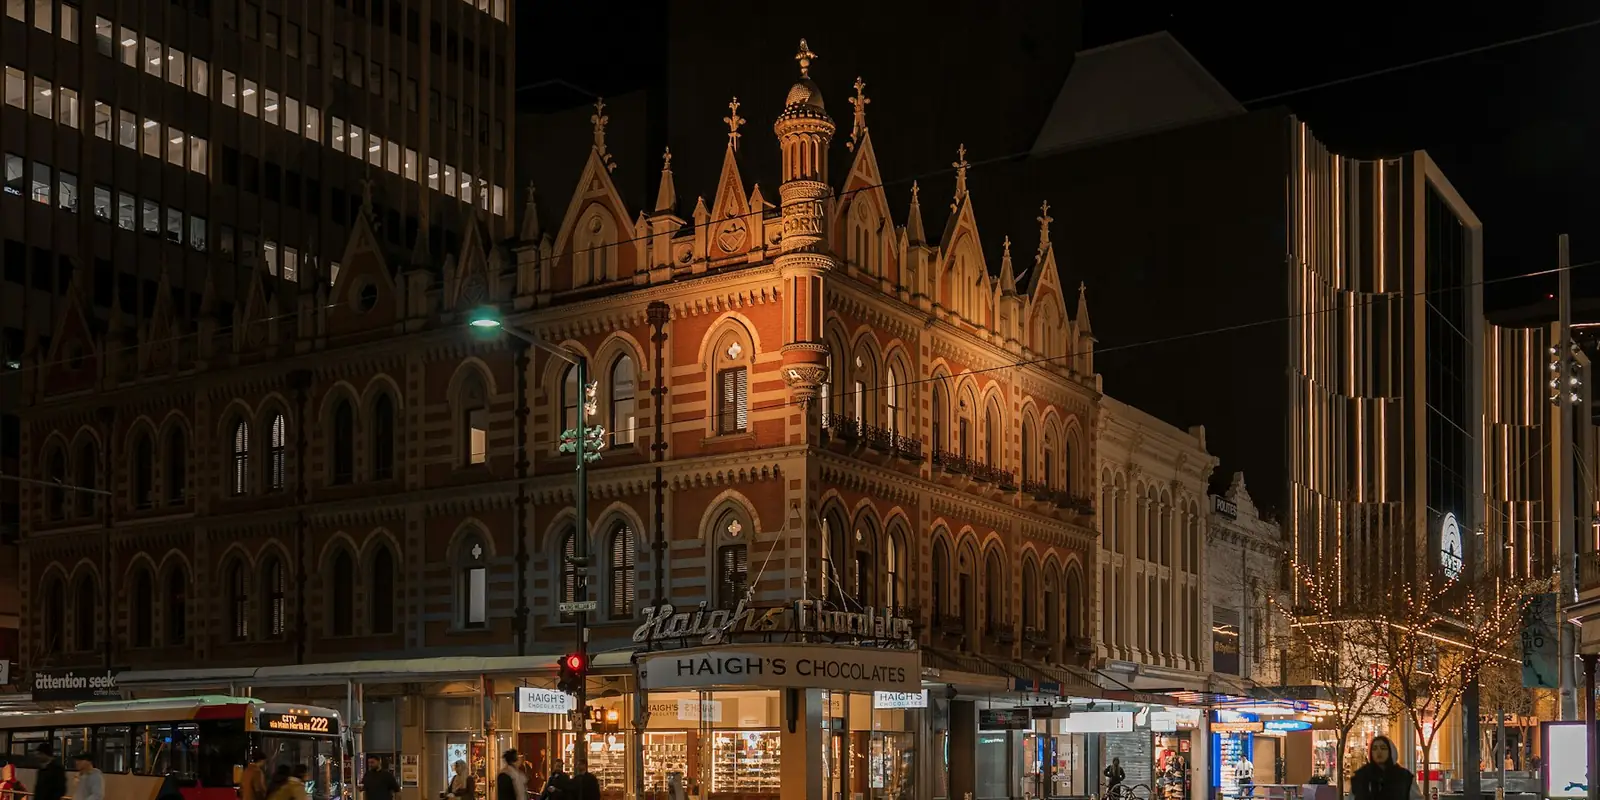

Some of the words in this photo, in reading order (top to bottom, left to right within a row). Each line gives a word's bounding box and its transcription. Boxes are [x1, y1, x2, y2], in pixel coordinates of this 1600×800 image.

[677, 658, 787, 676] HAIGH'S
[796, 659, 905, 683] CHOCOLATES
[35, 672, 87, 690] attention
[88, 669, 116, 689] seek
[528, 692, 565, 704] HAIGH'S
[880, 692, 923, 702] HAIGH'S
[278, 721, 290, 730] Main
[290, 722, 303, 730] North
[311, 717, 328, 732] 222
